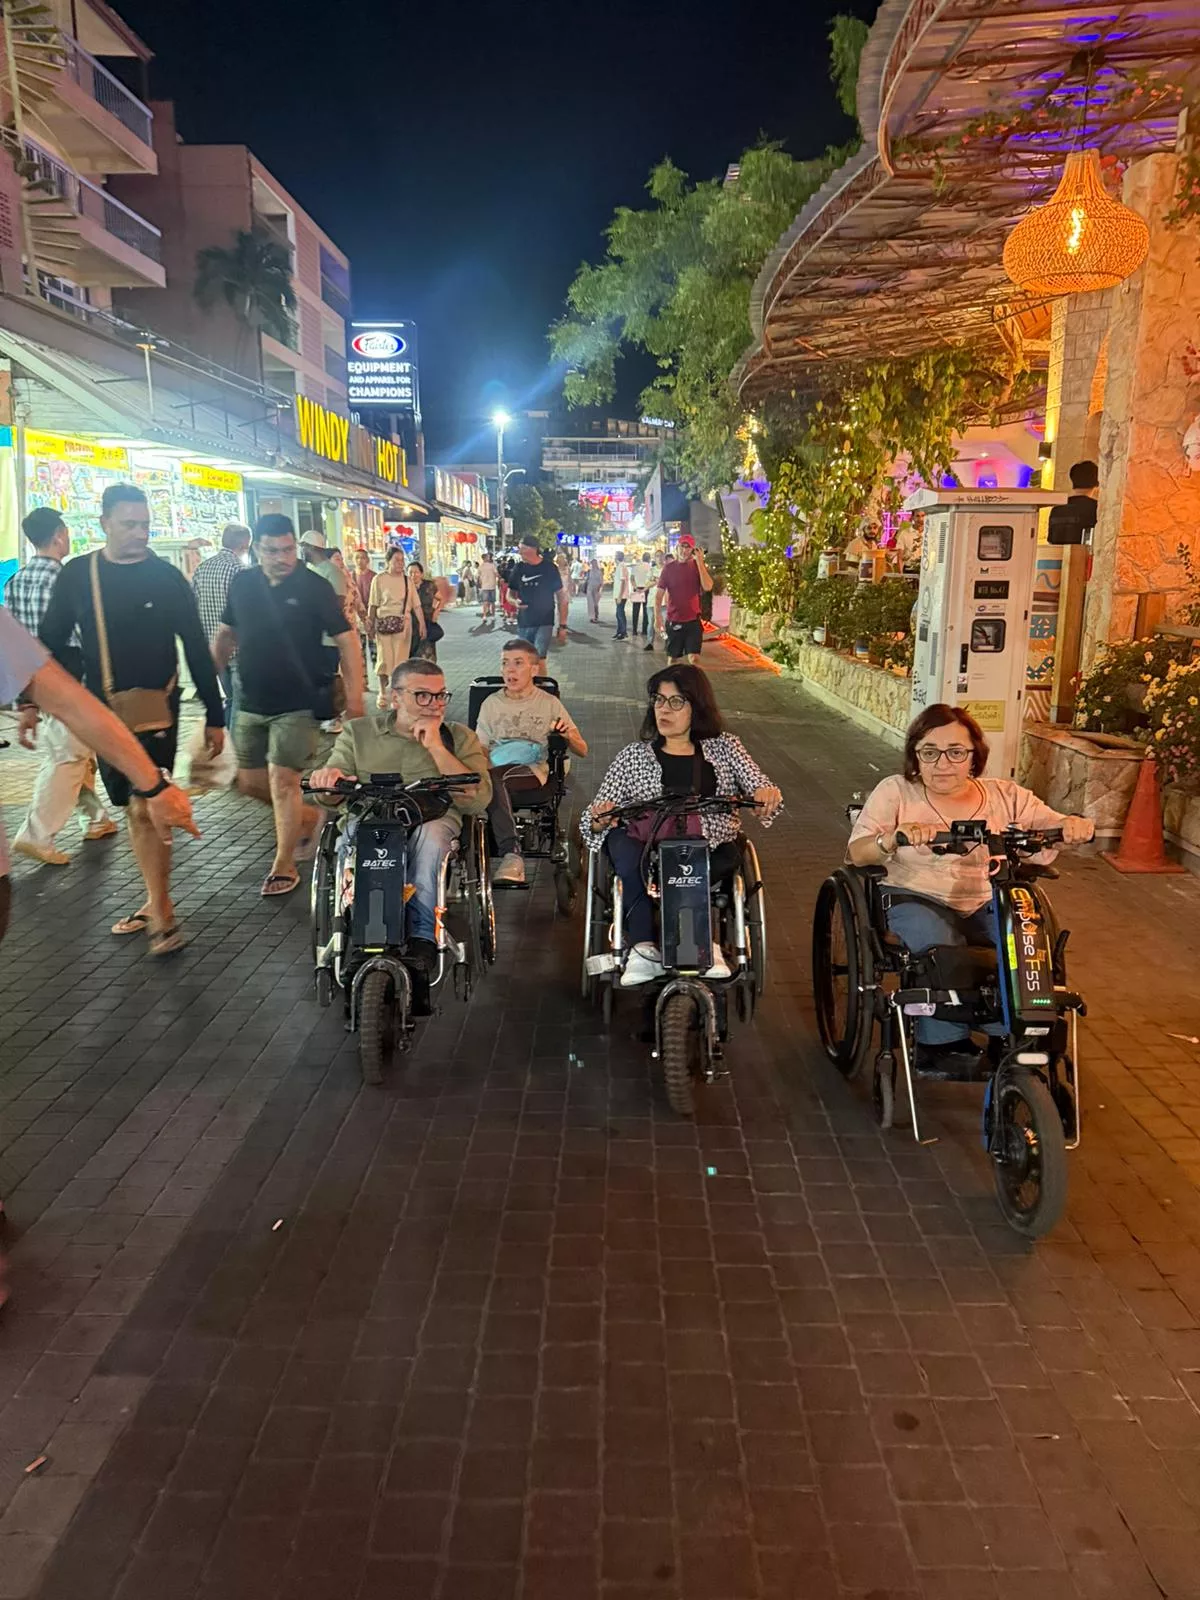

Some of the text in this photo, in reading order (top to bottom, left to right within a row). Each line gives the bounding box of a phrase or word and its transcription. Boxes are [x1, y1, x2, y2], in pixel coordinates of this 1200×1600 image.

[347, 361, 411, 374] EQUIPMENT
[349, 376, 411, 384] AND APPAREL FOR
[348, 386, 412, 397] CHAMPIONS
[296, 393, 349, 465] WINDY
[1024, 959, 1041, 992] F55
